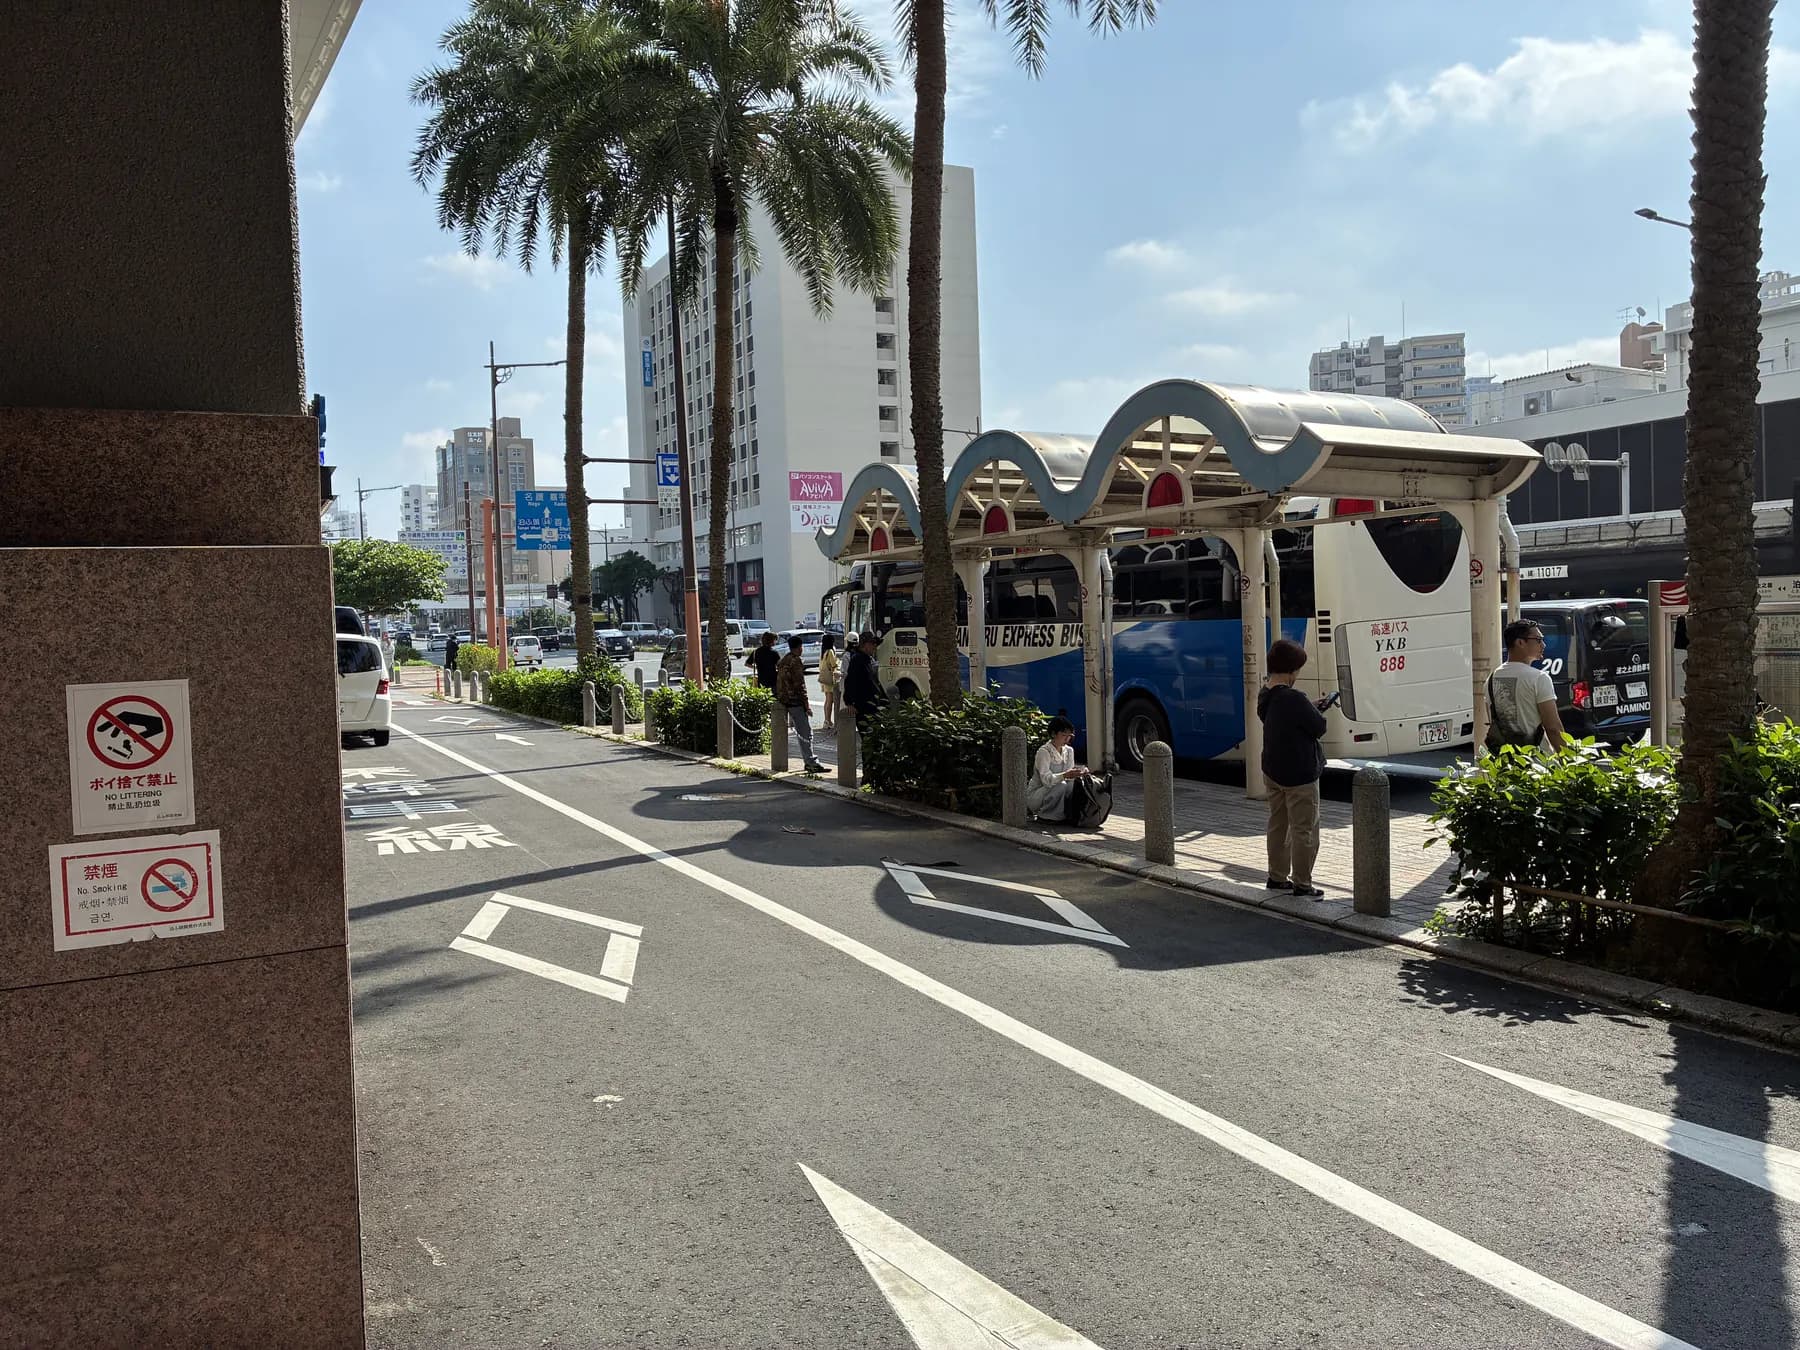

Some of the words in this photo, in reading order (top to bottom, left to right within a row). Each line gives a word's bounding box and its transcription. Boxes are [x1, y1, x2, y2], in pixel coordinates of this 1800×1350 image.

[1537, 567, 1561, 577] 11017
[1002, 625, 1055, 647] EXPRESS
[1060, 624, 1084, 647] BUS
[1370, 621, 1409, 637] 高速バス
[1375, 637, 1407, 652] YKB
[1380, 655, 1405, 672] 888
[1541, 659, 1563, 675] 20
[1616, 701, 1650, 714] NAMINO
[89, 772, 178, 791] ポイ捨て禁止
[105, 793, 117, 801] NO
[120, 790, 162, 800] LITTERING
[83, 863, 118, 881] 禁煙
[92, 884, 128, 894] Smoking
